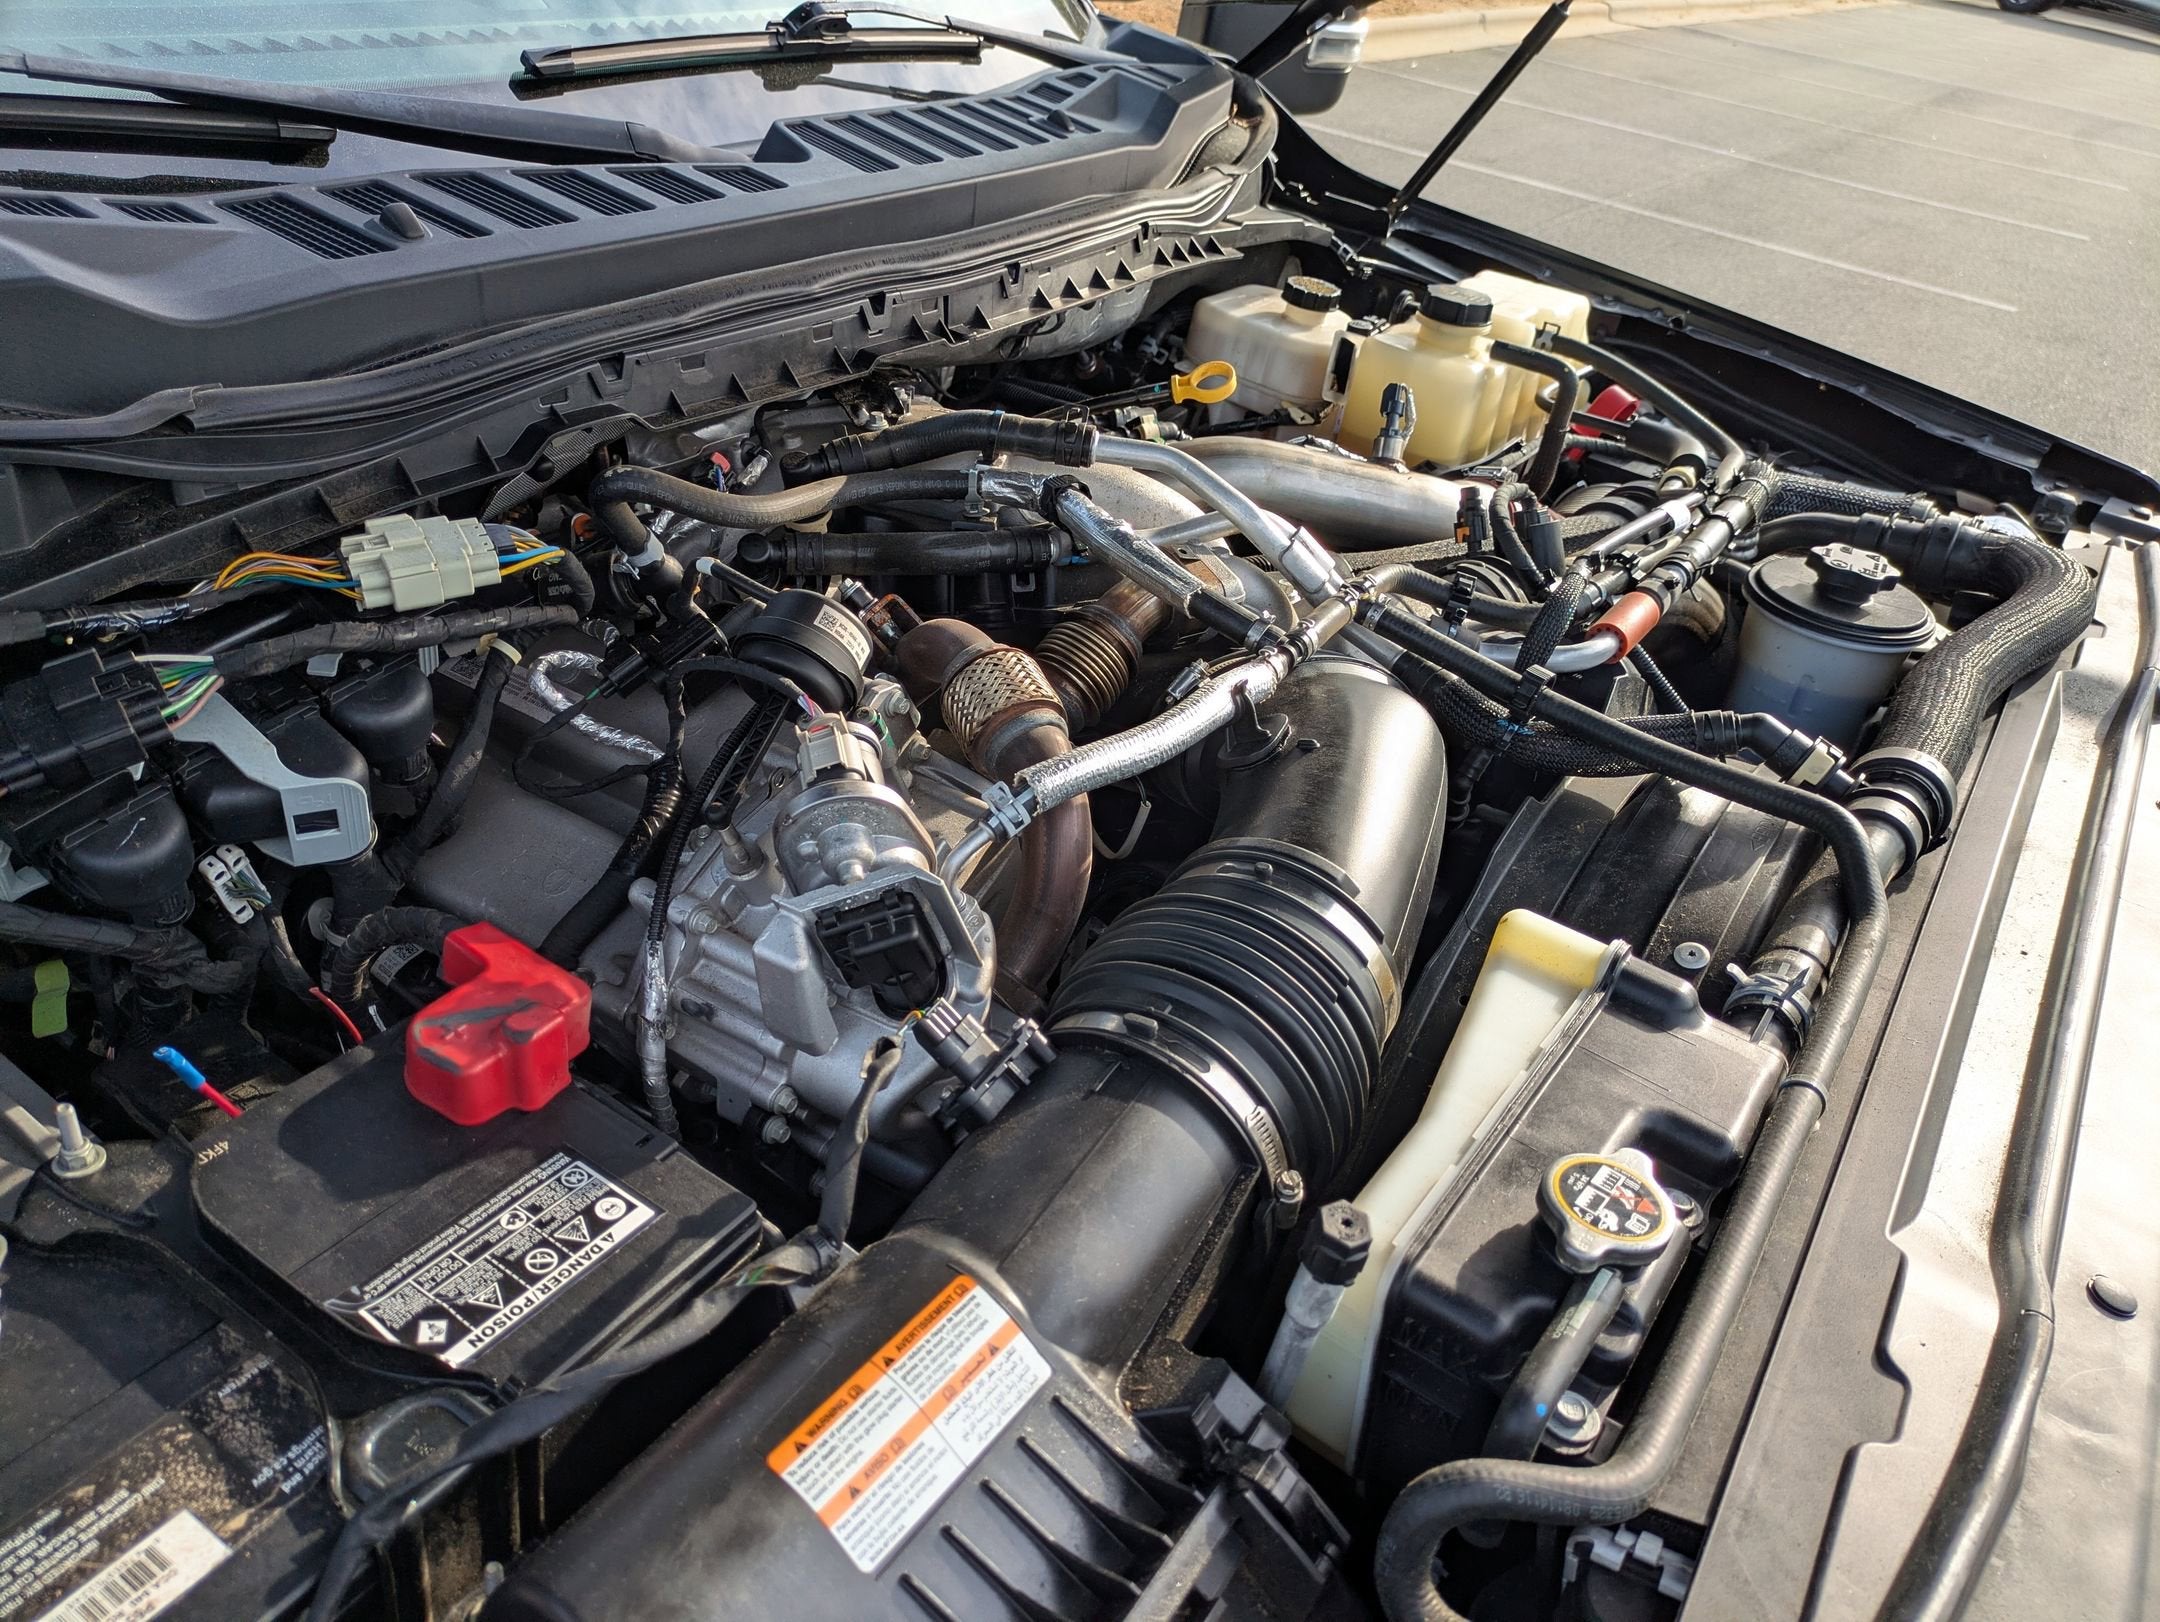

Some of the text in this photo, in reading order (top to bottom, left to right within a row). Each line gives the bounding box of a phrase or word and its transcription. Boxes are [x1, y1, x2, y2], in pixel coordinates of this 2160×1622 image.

[533, 1183, 565, 1205] OF REACH
[547, 1180, 559, 1188] OF
[539, 1187, 570, 1209] KEEP OUT
[487, 1228, 508, 1243] READ
[420, 1259, 463, 1290] DO NOT TIP
[437, 1257, 453, 1268] OR
[460, 1260, 487, 1279] SEVERE
[445, 1263, 492, 1297] BLINDNESS OR
[460, 1267, 498, 1295] CAN CAUSE
[465, 1243, 605, 1348] DANGER/POISON
[893, 1293, 956, 1352] AVERTISSEMENT
[805, 1397, 848, 1438] WARNING
[861, 1451, 890, 1480] AVISO
[280, 1471, 304, 1494] and
